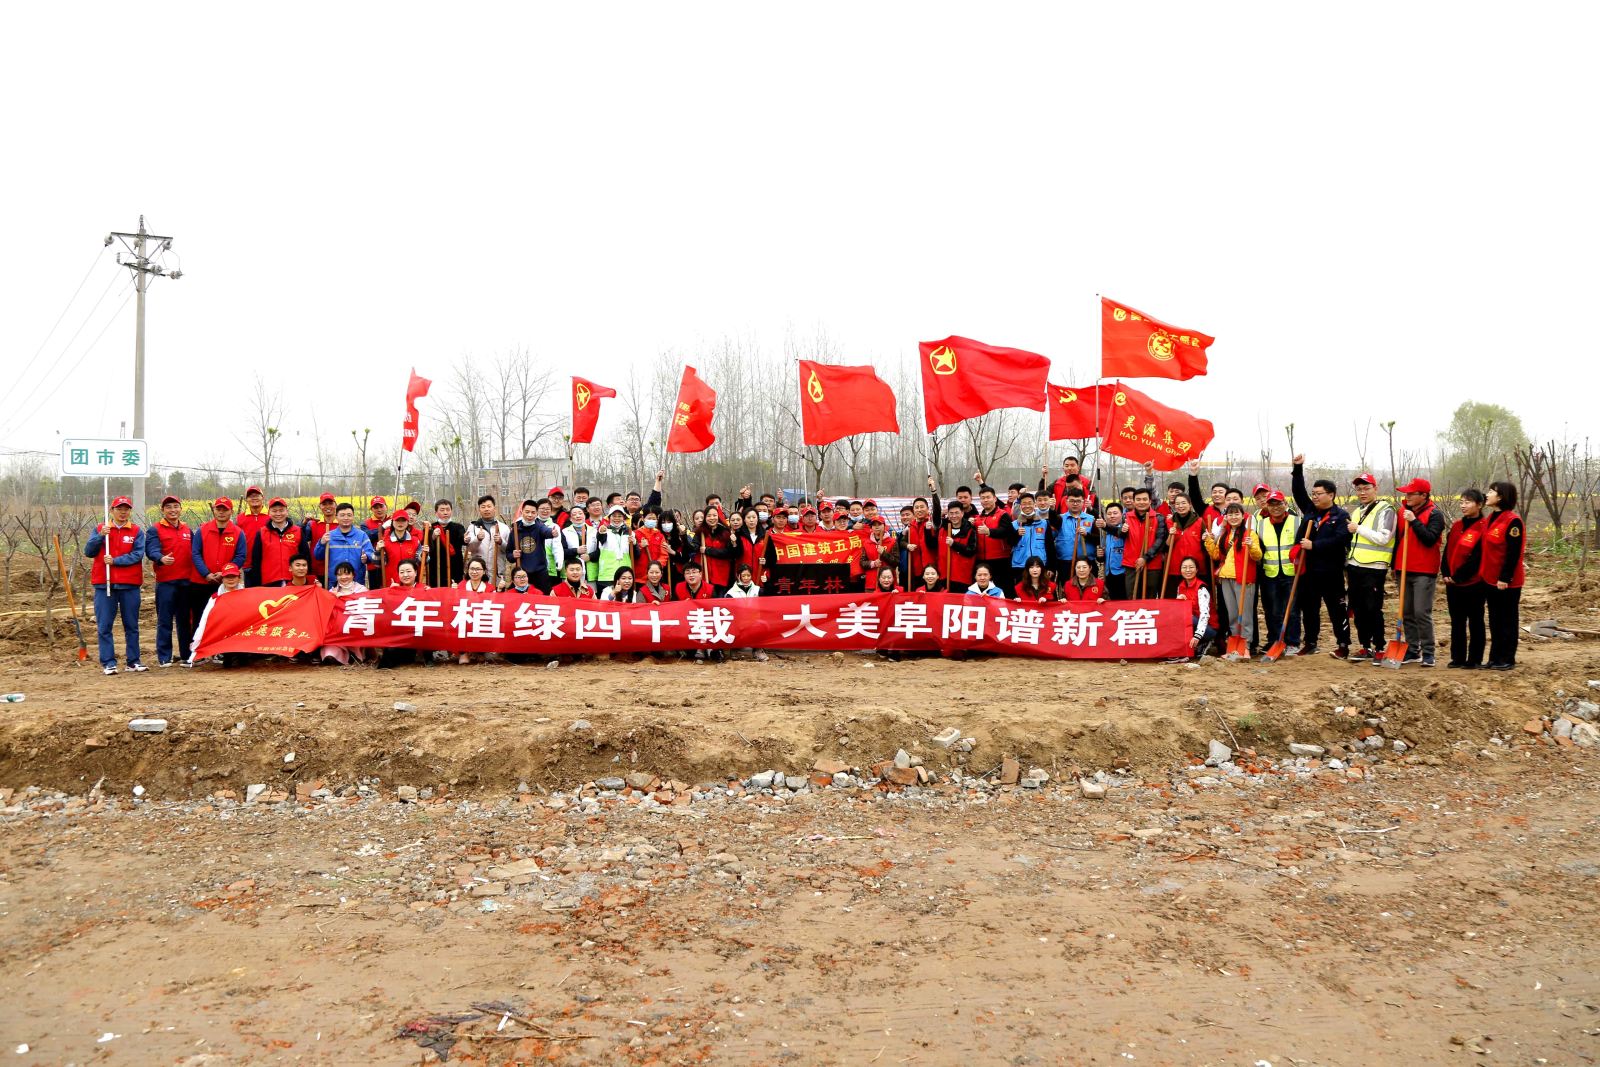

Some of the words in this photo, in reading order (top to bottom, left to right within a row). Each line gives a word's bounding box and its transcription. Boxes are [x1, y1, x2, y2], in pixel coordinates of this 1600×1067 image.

[1119, 430, 1138, 441] HAO
[1141, 438, 1163, 451] YUAN
[71, 448, 140, 466] 团市委
[774, 576, 845, 594] 青年林
[342, 597, 736, 644] 青年植绿四十载
[781, 602, 1160, 646] 大美阜阳谱新篇
